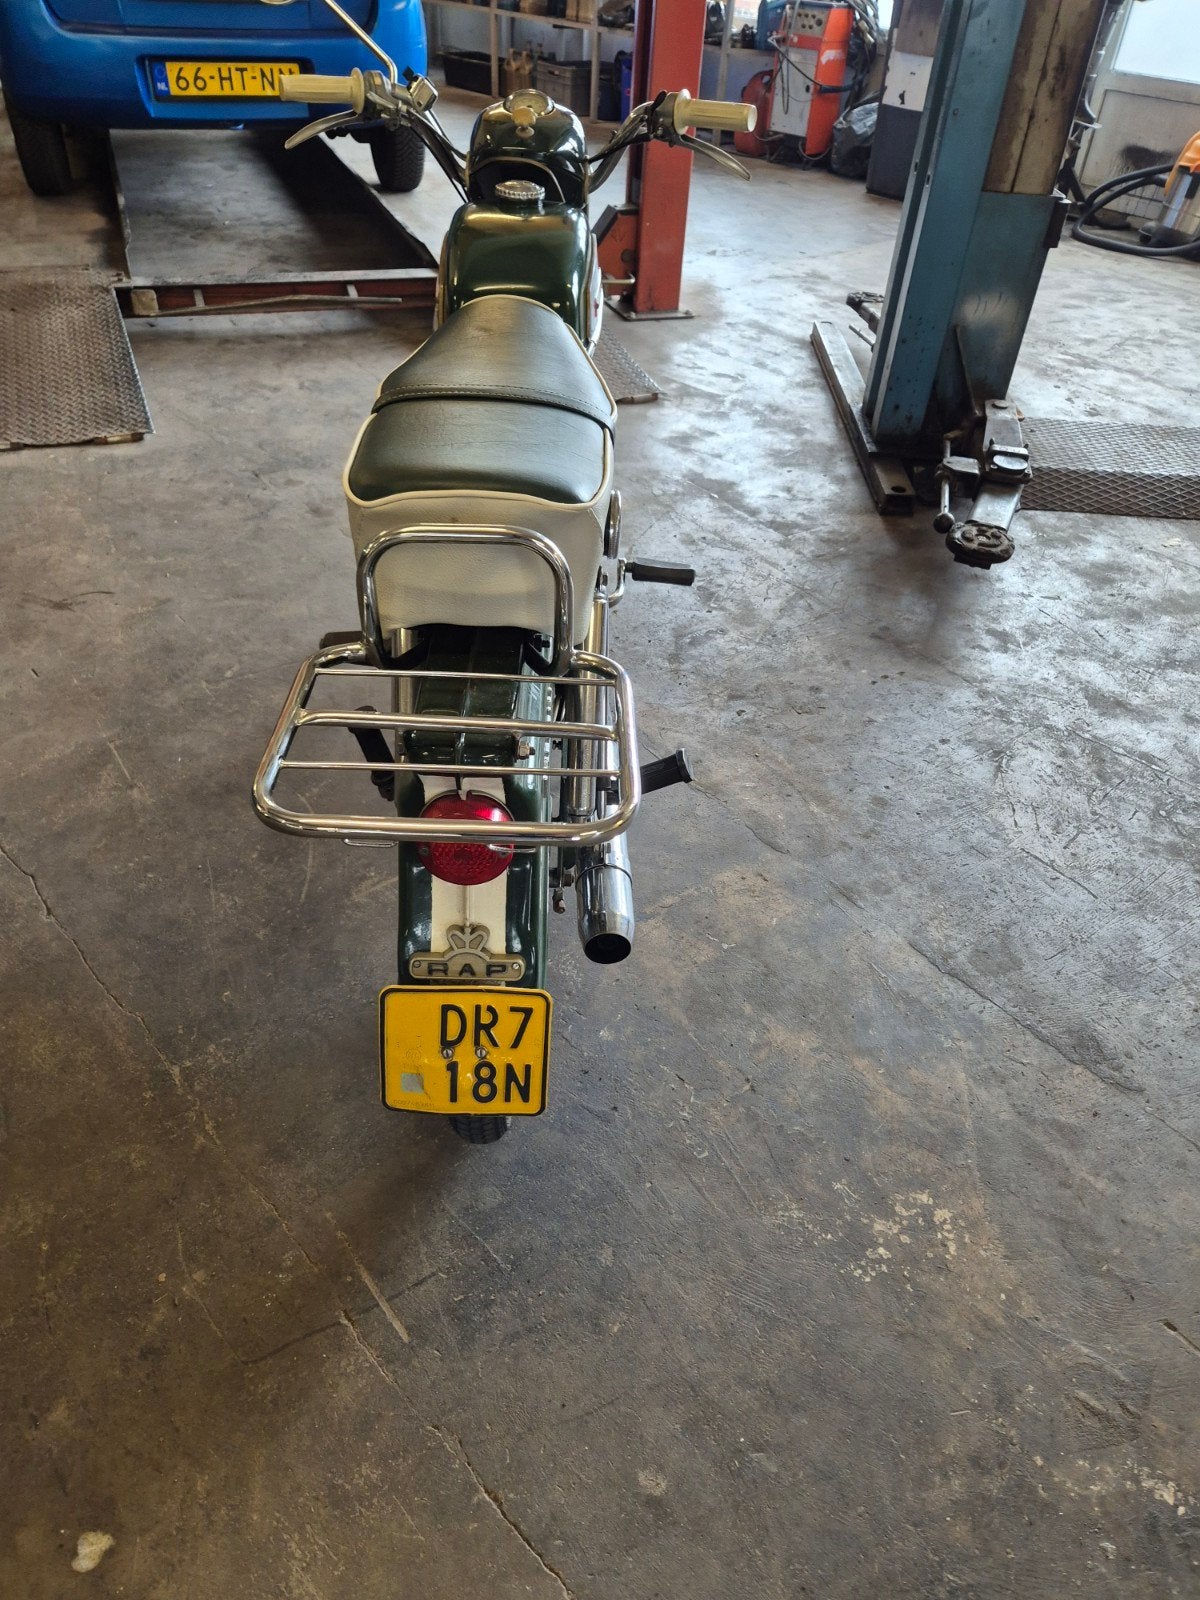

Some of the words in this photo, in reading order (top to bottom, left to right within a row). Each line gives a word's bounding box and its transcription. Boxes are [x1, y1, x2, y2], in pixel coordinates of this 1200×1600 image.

[157, 82, 169, 91] NL
[175, 67, 294, 92] 66-HT-N
[427, 961, 508, 977] RAP
[440, 1003, 534, 1049] DR7
[446, 1060, 531, 1104] 18N
